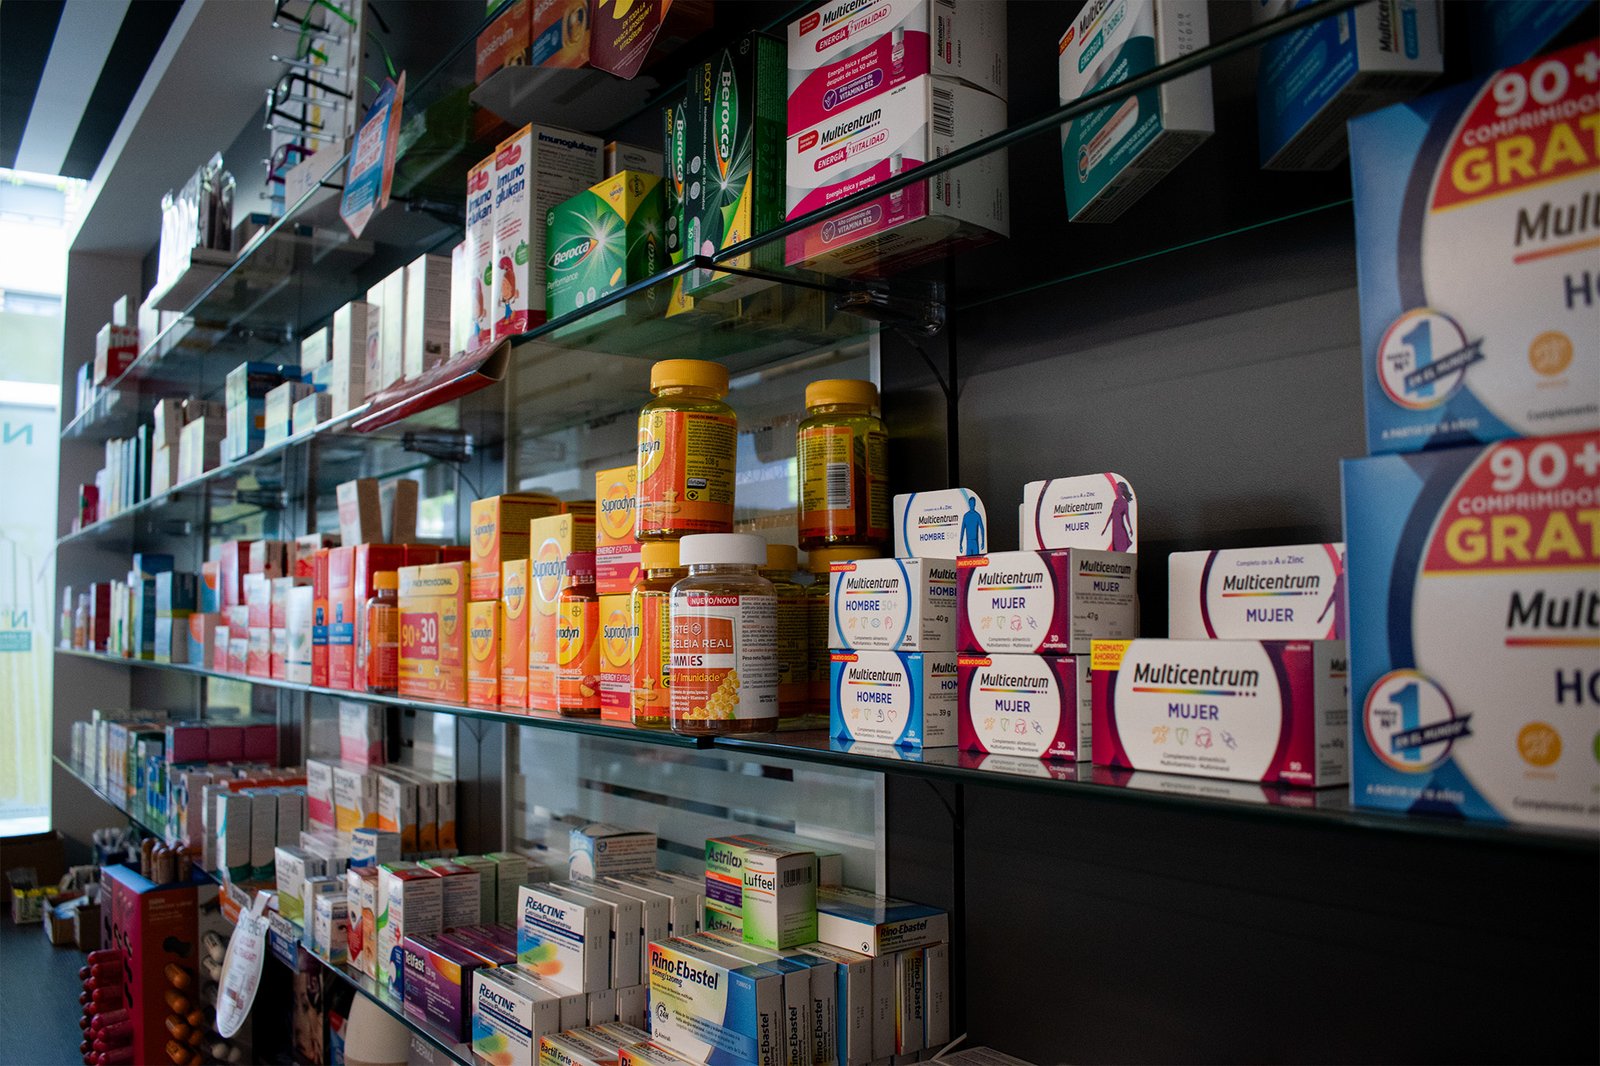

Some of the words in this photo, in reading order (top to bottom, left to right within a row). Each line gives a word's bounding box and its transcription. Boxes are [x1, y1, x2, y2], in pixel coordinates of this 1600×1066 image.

[818, 30, 847, 50] ENERGÍA
[853, 8, 888, 31] VITALIDAD
[704, 63, 712, 103] BOOST
[720, 71, 732, 159] Berocca
[821, 108, 882, 145] Multicentrum
[538, 132, 598, 153] Imunoglukan
[676, 120, 684, 184] Berocca
[817, 151, 845, 169] ENERGÍA
[851, 133, 886, 154] VITALIDAD
[1451, 113, 1600, 195] GRAT
[687, 227, 694, 240] 30
[553, 240, 591, 267] Berocca
[601, 496, 636, 515] Supradyn
[1053, 501, 1103, 514] Multicentrum
[918, 513, 959, 525] Multicentrum
[1065, 521, 1089, 532] MUJER
[919, 531, 945, 542] HOMBRE
[1445, 509, 1600, 564] GRAT
[596, 546, 616, 555] ENERGY
[616, 544, 632, 553] EXTRA
[1274, 557, 1280, 565] A
[1287, 555, 1304, 565] Zinc
[532, 558, 568, 579] Supradyn
[1079, 560, 1132, 576] Multicentrum
[846, 578, 899, 590] Multicentrum
[978, 571, 1044, 586] Multicentrum
[1223, 574, 1320, 591] Multicentrum
[1093, 580, 1120, 593] MUJER
[691, 597, 738, 606] NUEVO/NOVO
[846, 600, 880, 611] HOMBRE
[881, 600, 898, 611] 50+
[992, 597, 1026, 609] MUJER
[1507, 588, 1600, 630] Mult
[936, 615, 943, 623] 40
[1246, 608, 1294, 622] MUJER
[402, 624, 415, 649] 90
[420, 617, 437, 644] 30
[1050, 634, 1059, 643] 30
[702, 639, 733, 649] REAL
[673, 656, 703, 667] MMIES
[600, 673, 616, 683] ENERGY
[616, 673, 630, 682] EXTRA
[849, 668, 902, 682] Multicentrum
[980, 673, 1049, 688] Multicentrum
[1133, 662, 1260, 688] Multicentrum
[942, 680, 958, 690] HOM
[857, 691, 892, 704] HOMBRE
[995, 699, 1031, 713] MUJER
[1168, 703, 1220, 721] MUJER
[1057, 741, 1066, 749] 30
[1289, 761, 1303, 772] 90
[744, 872, 776, 891] Luffeel
[525, 896, 566, 921] REACTINE
[708, 914, 738, 932] Astril
[880, 919, 928, 938] Rino-Ebastel
[404, 950, 426, 974] Telfast
[479, 983, 516, 1014] REACTINE
[540, 1041, 558, 1058] Bactil
[557, 1050, 572, 1066] Forte
